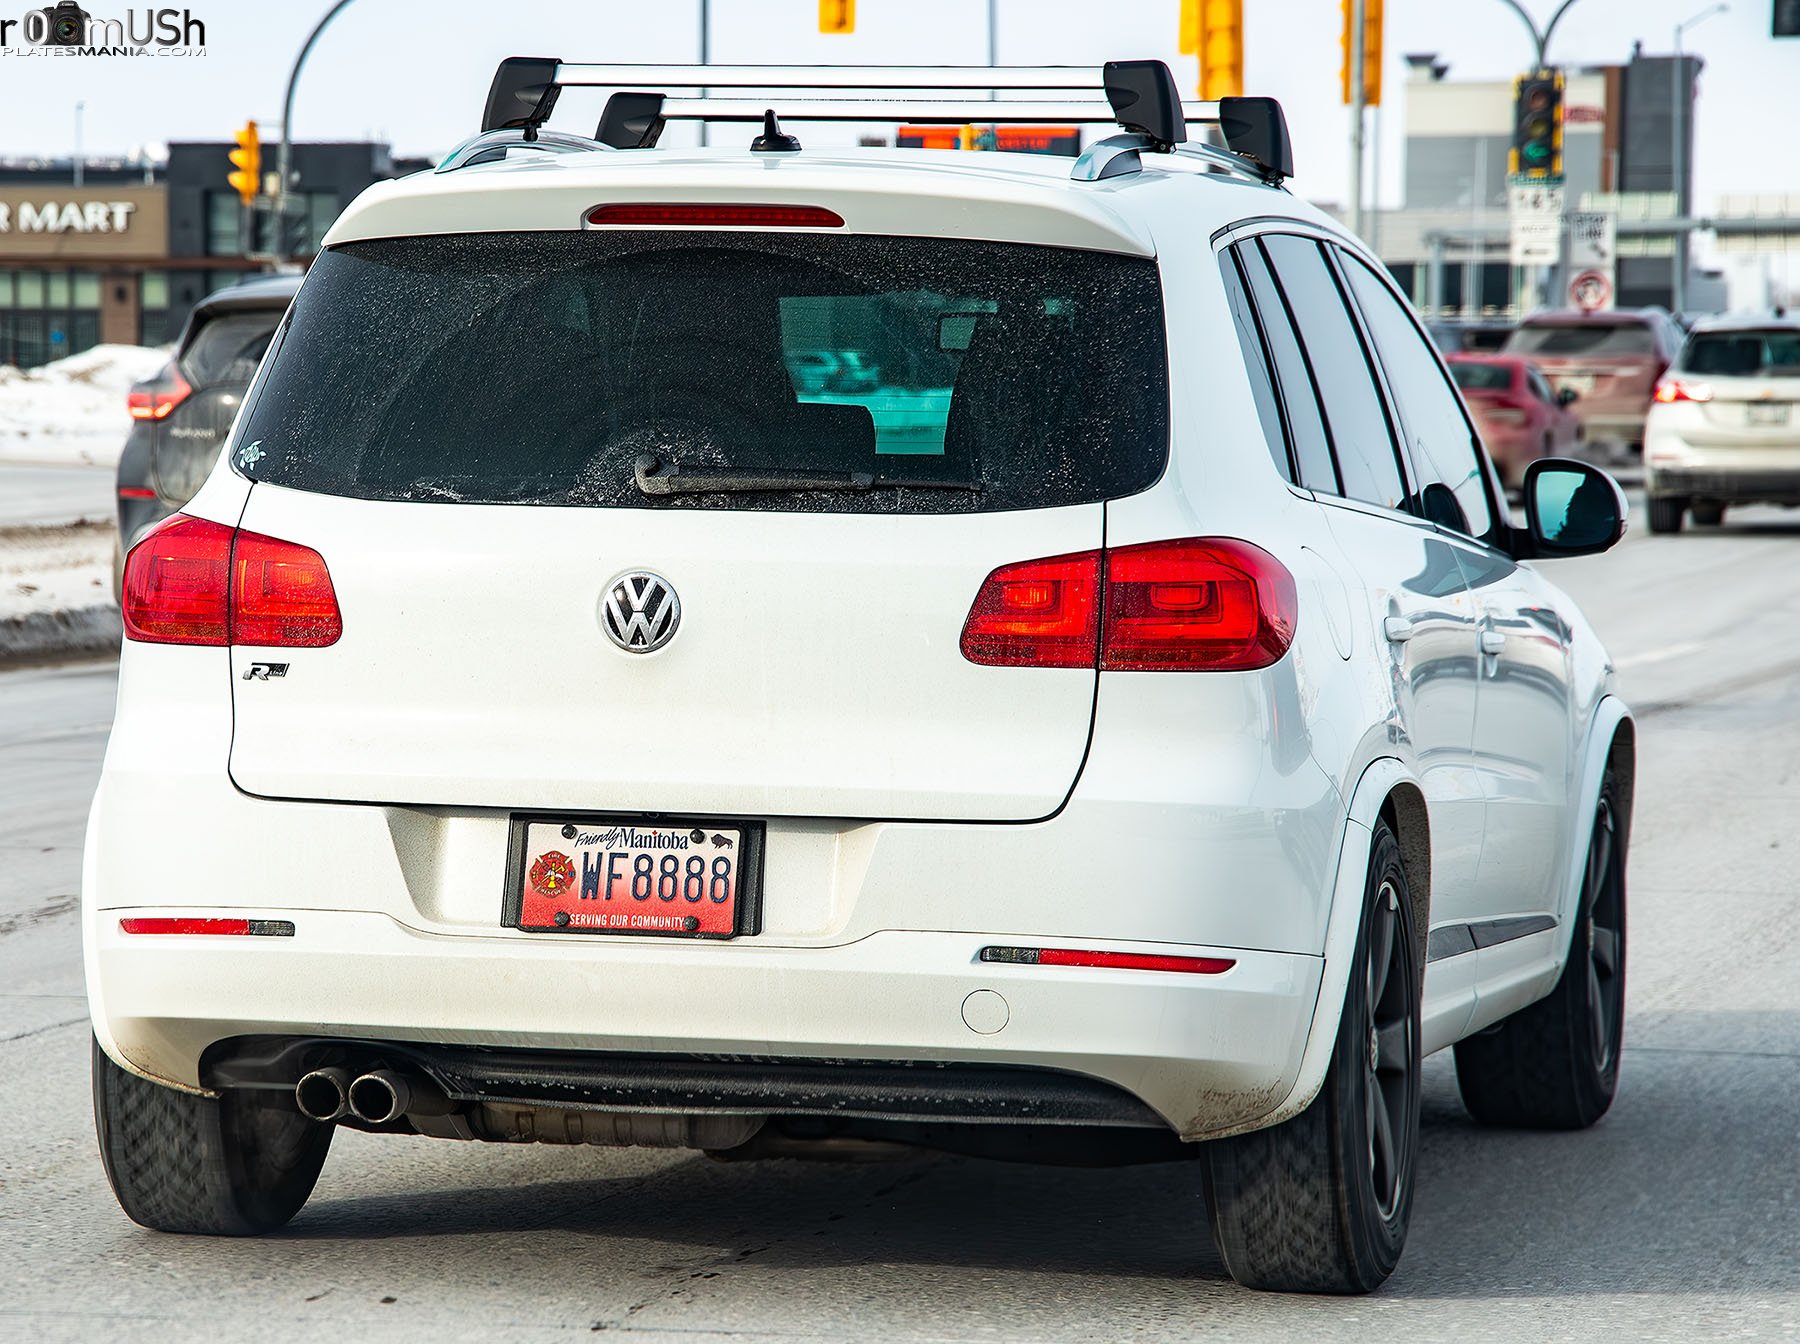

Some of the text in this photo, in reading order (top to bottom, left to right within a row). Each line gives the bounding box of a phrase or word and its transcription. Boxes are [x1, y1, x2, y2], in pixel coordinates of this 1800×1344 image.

[18, 201, 136, 233] MART
[574, 826, 689, 850] Friendly Manitoba
[581, 851, 732, 904] WF8888
[569, 913, 685, 928] SERVING OUR COMMUNITY
